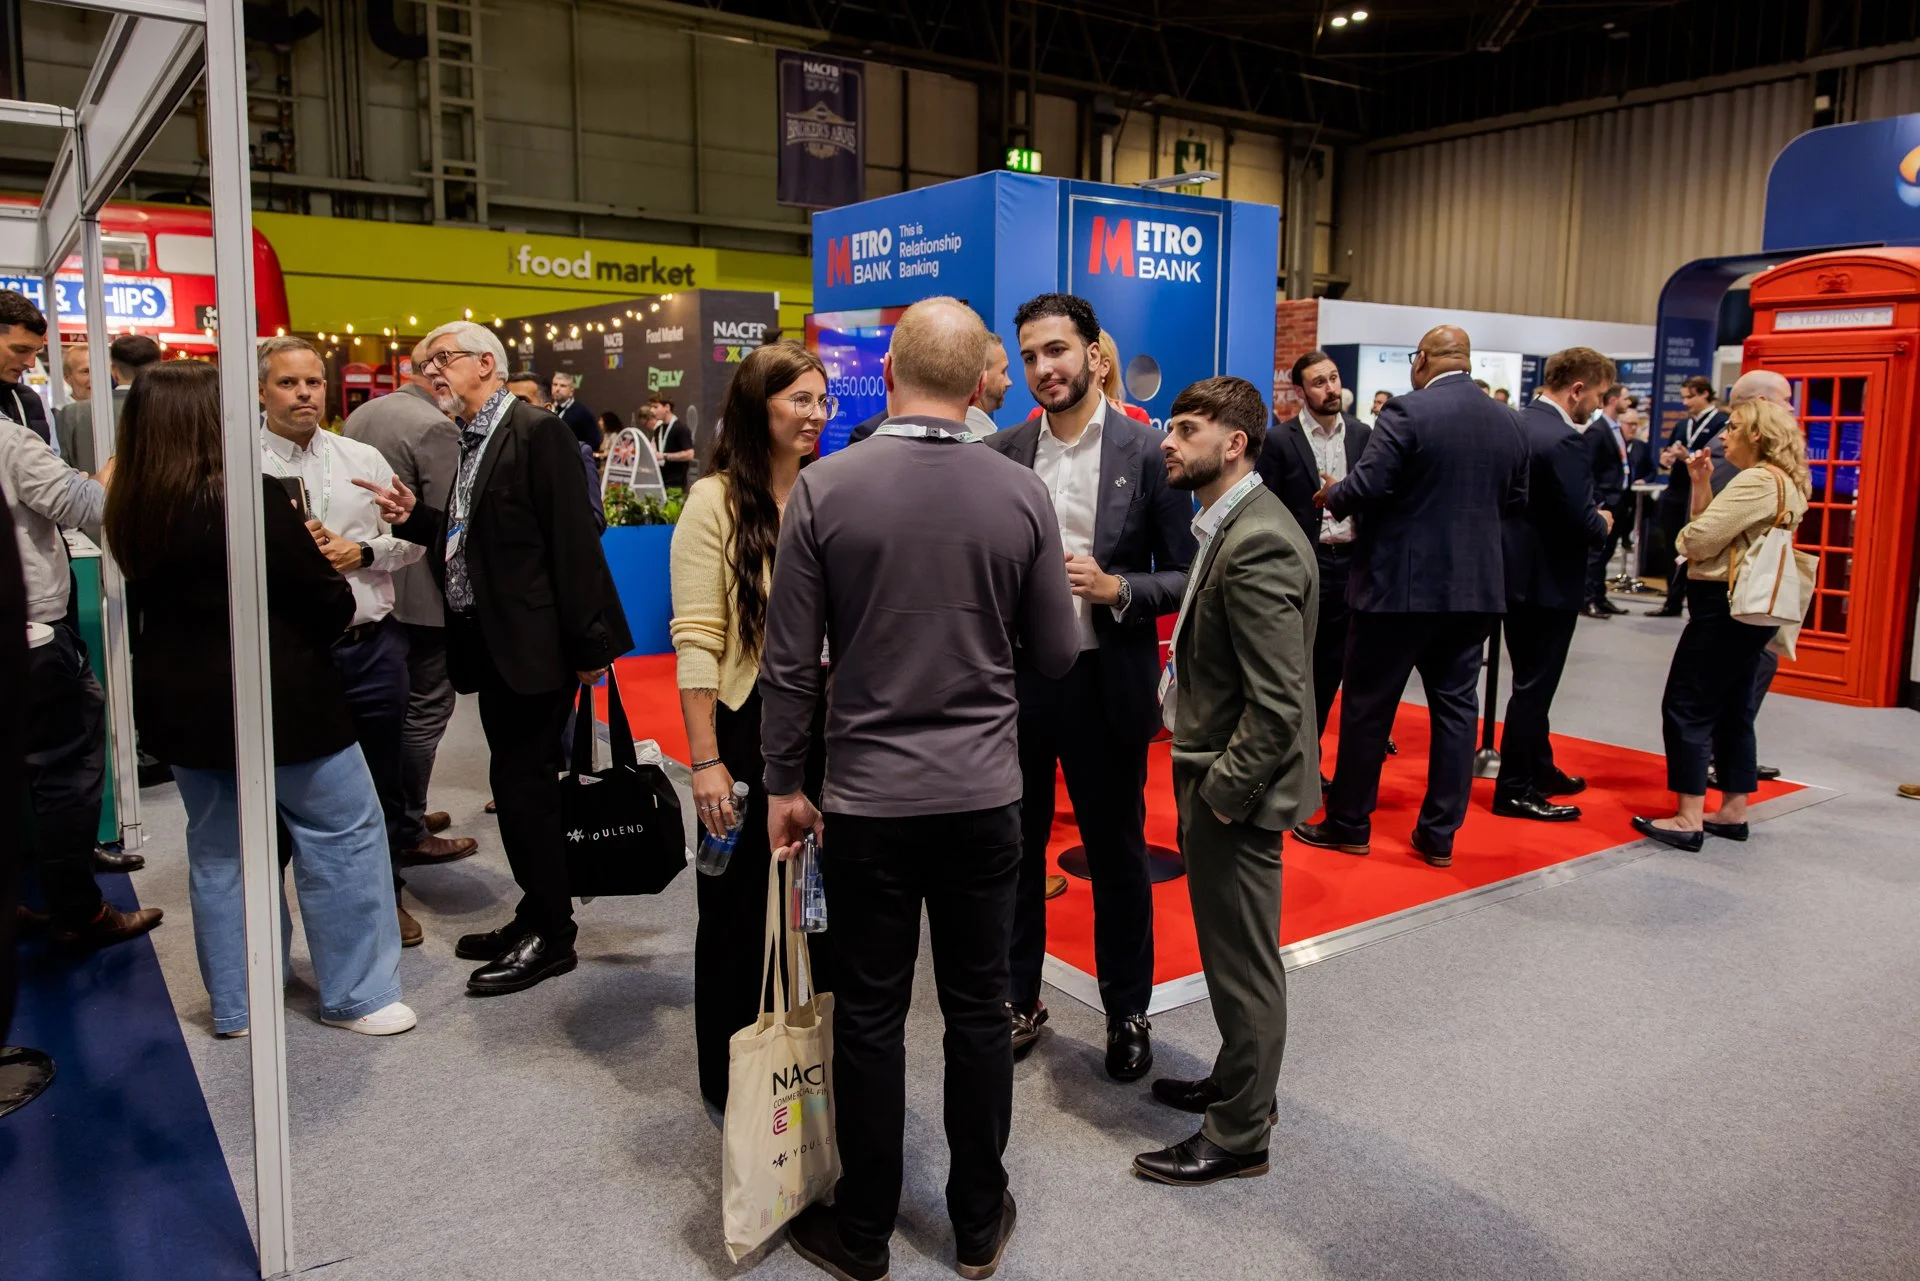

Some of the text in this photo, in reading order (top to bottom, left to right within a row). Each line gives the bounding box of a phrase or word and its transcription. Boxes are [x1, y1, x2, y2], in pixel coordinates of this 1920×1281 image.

[803, 61, 839, 77] NACFB
[899, 222, 923, 238] This is
[899, 232, 962, 258] Relationship
[1088, 216, 1203, 277] METRO
[517, 244, 592, 279] food
[596, 256, 696, 287] market
[827, 227, 893, 288] METRO
[899, 259, 939, 278] Banking
[1138, 256, 1202, 283] BANK
[854, 260, 892, 285] BANK
[1800, 312, 1867, 326] TELEPHONE
[646, 325, 684, 344] Food Market
[648, 367, 684, 392] RELY
[827, 375, 885, 398] £550,000
[773, 1087, 814, 1109] COMMERCIAL
